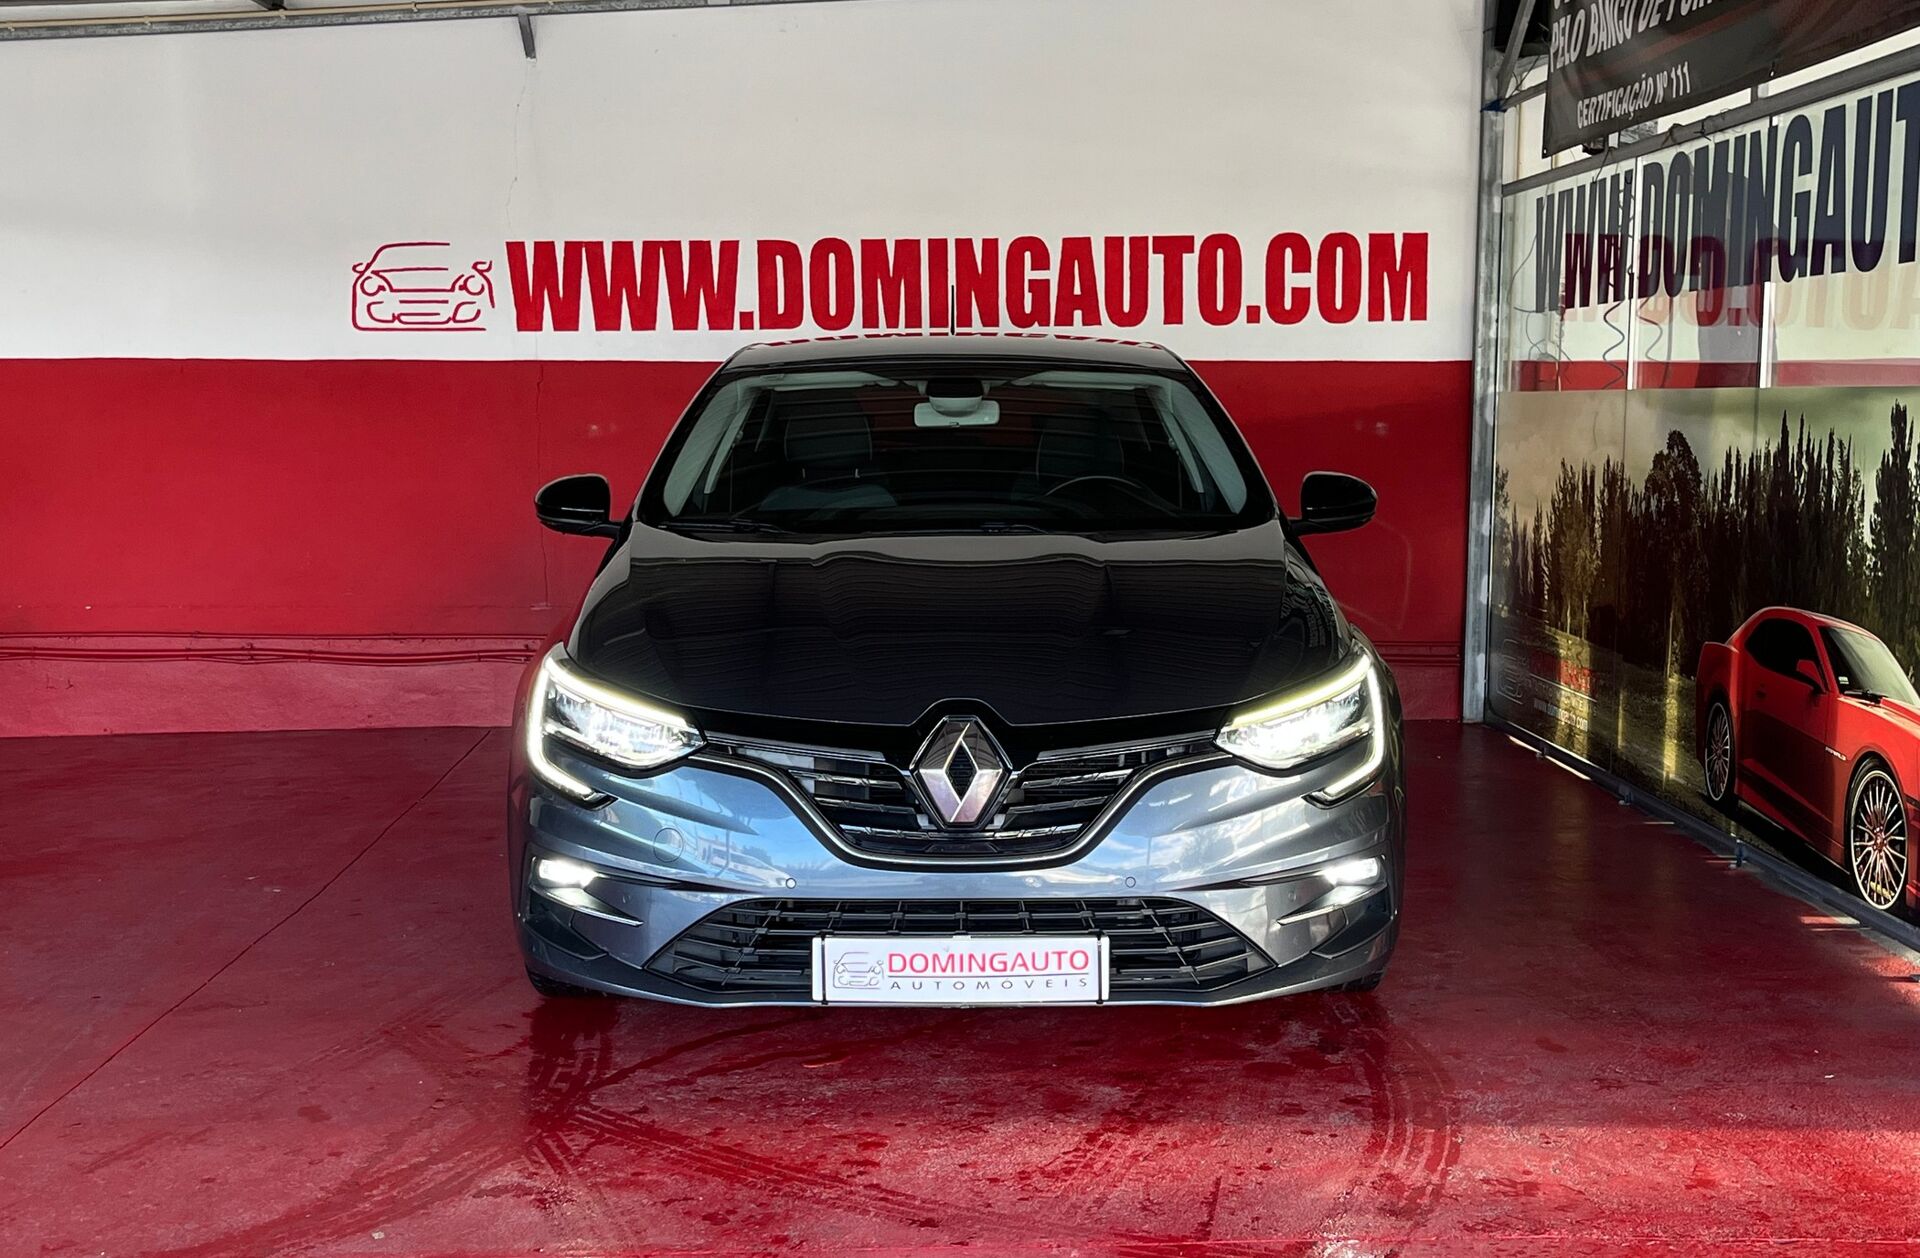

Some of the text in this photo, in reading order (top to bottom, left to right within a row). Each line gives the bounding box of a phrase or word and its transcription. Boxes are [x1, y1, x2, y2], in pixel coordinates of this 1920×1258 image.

[1550, 9, 1586, 73] PELO
[1586, 1, 1636, 57] BANCO
[1577, 72, 1654, 129] CERTIFICAÇÃO
[1671, 61, 1691, 98] 111
[505, 232, 1429, 332] WWW.DOMINGAUTO.COM
[888, 950, 1090, 974] DOMINGAUTO
[890, 977, 1088, 991] AUTOMÓVEIS
